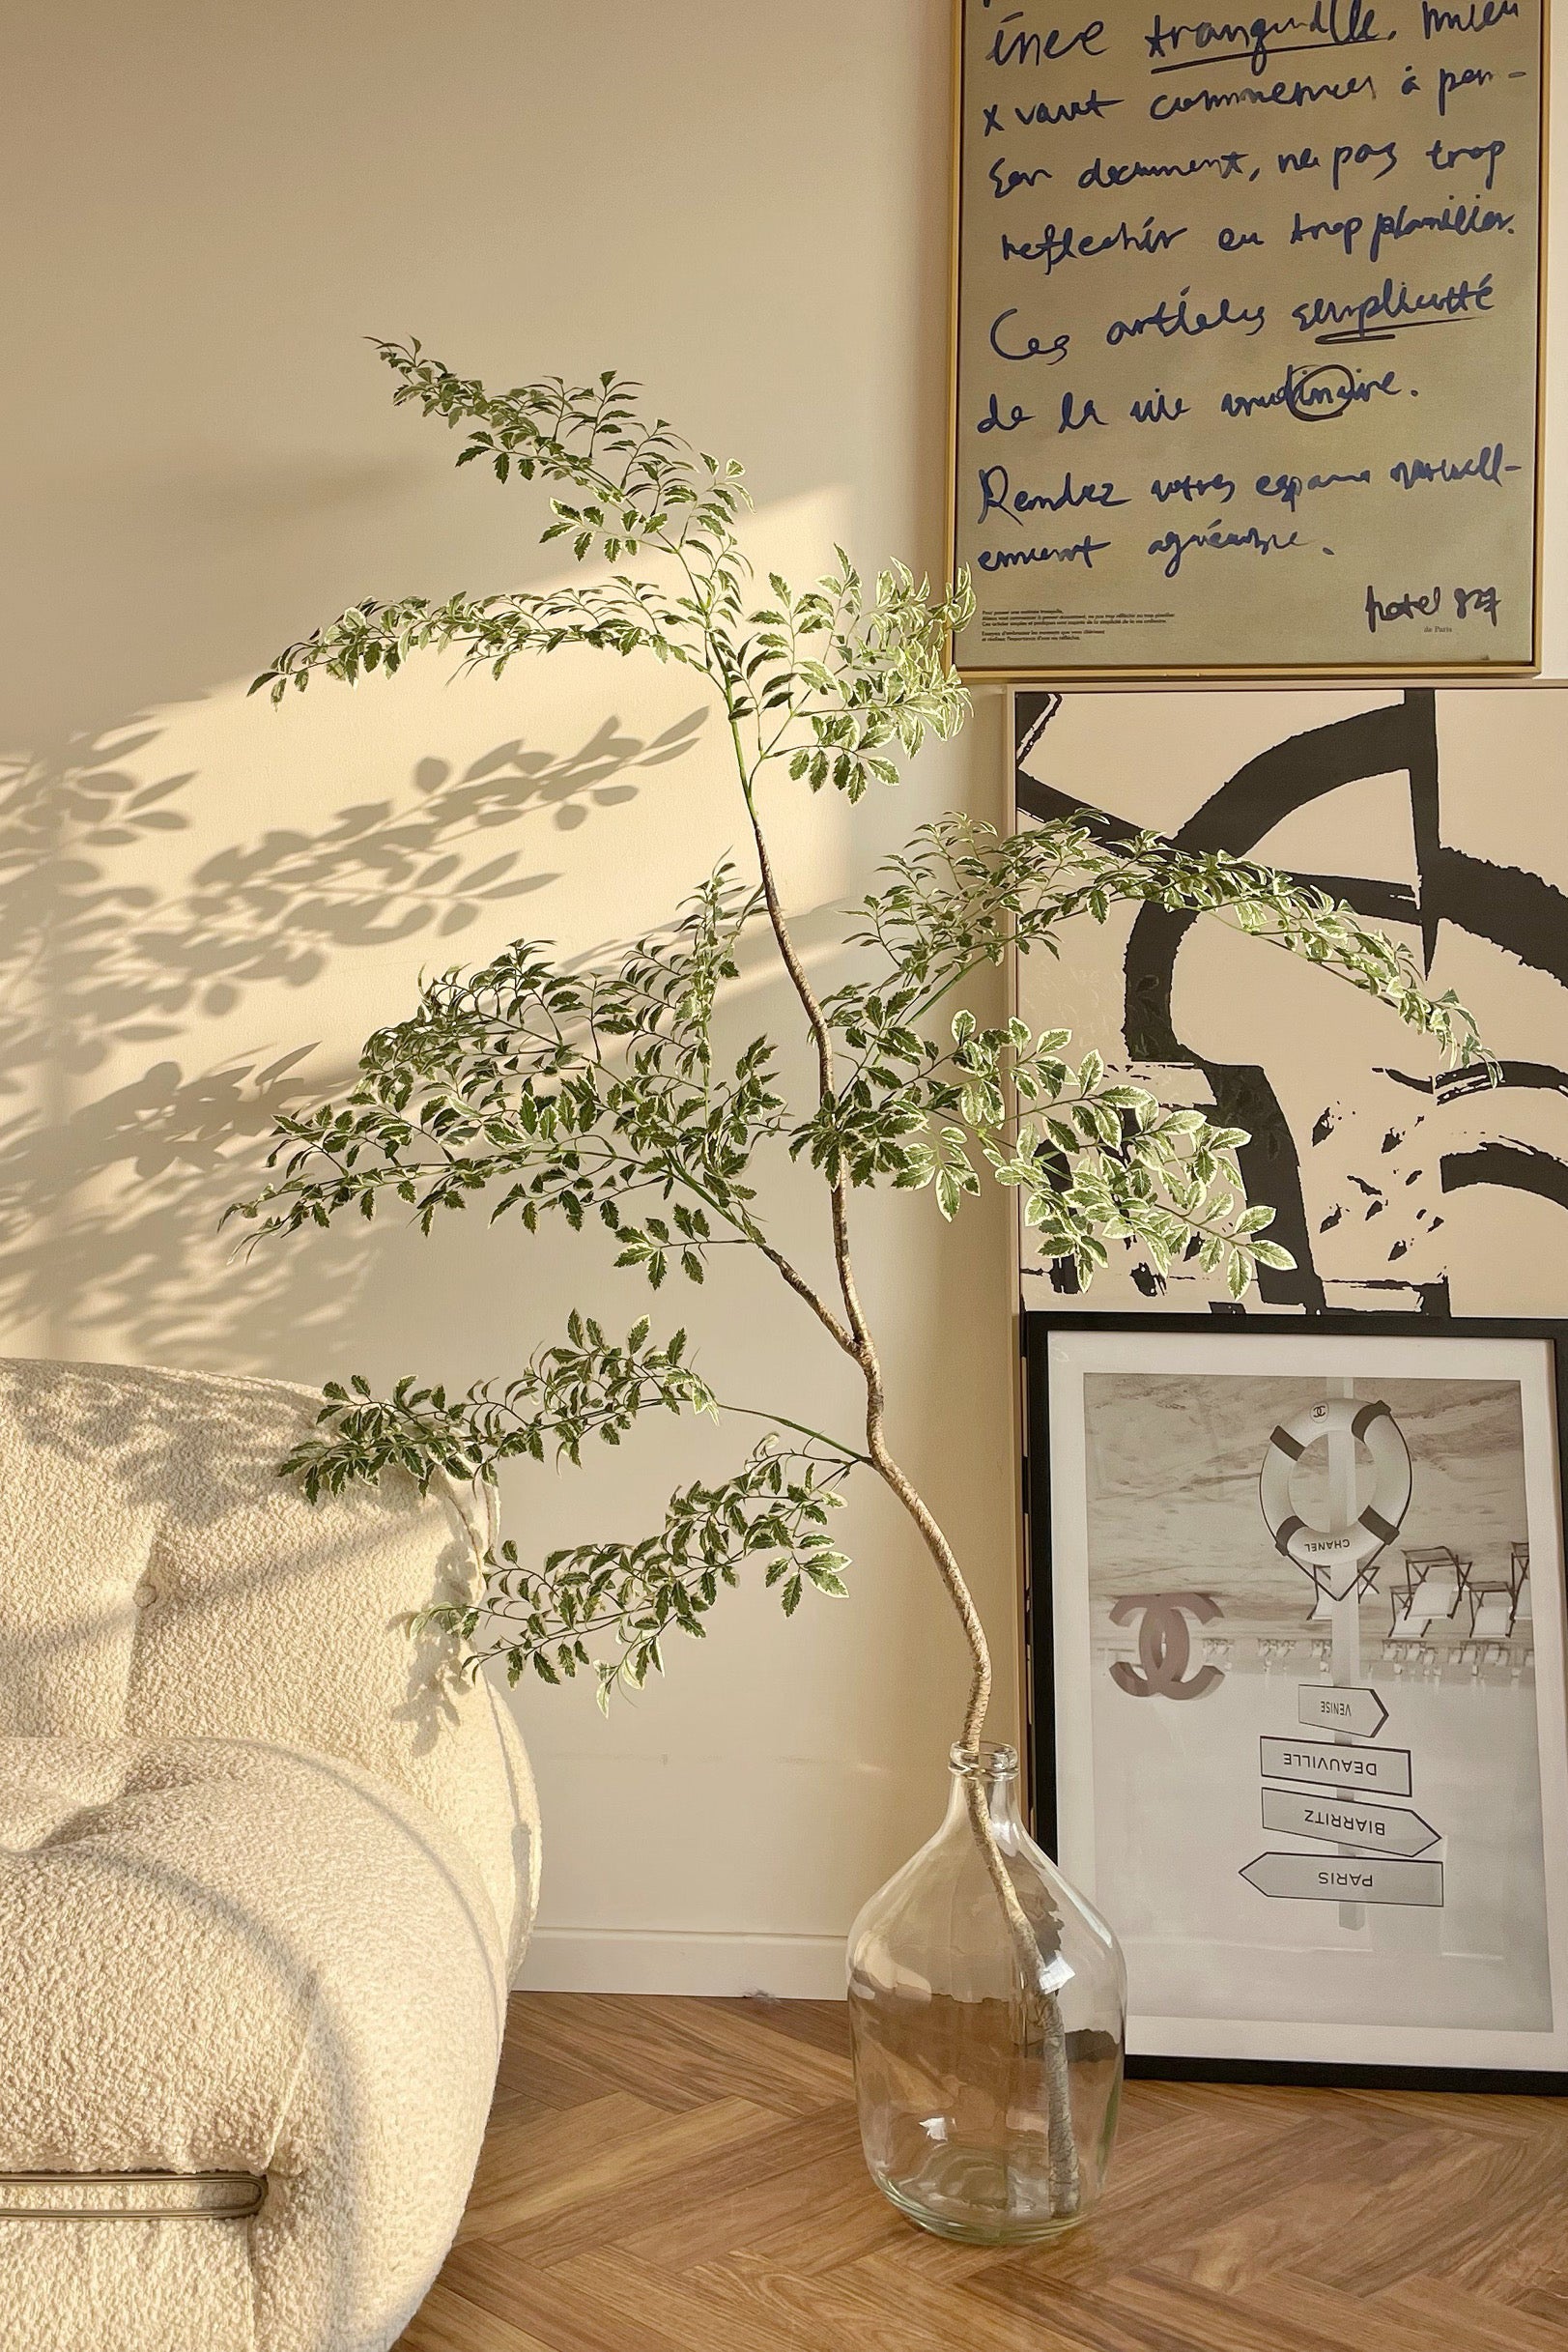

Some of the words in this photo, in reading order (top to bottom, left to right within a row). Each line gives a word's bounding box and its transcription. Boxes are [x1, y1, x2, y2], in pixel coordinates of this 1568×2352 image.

[1304, 1537, 1351, 1553] CHANEL
[1320, 1700, 1352, 1716] VENISE
[1282, 1753, 1378, 1776] DEAUVILLE
[1304, 1809, 1385, 1836] BIARRITZ
[1318, 1871, 1373, 1887] PARIS
